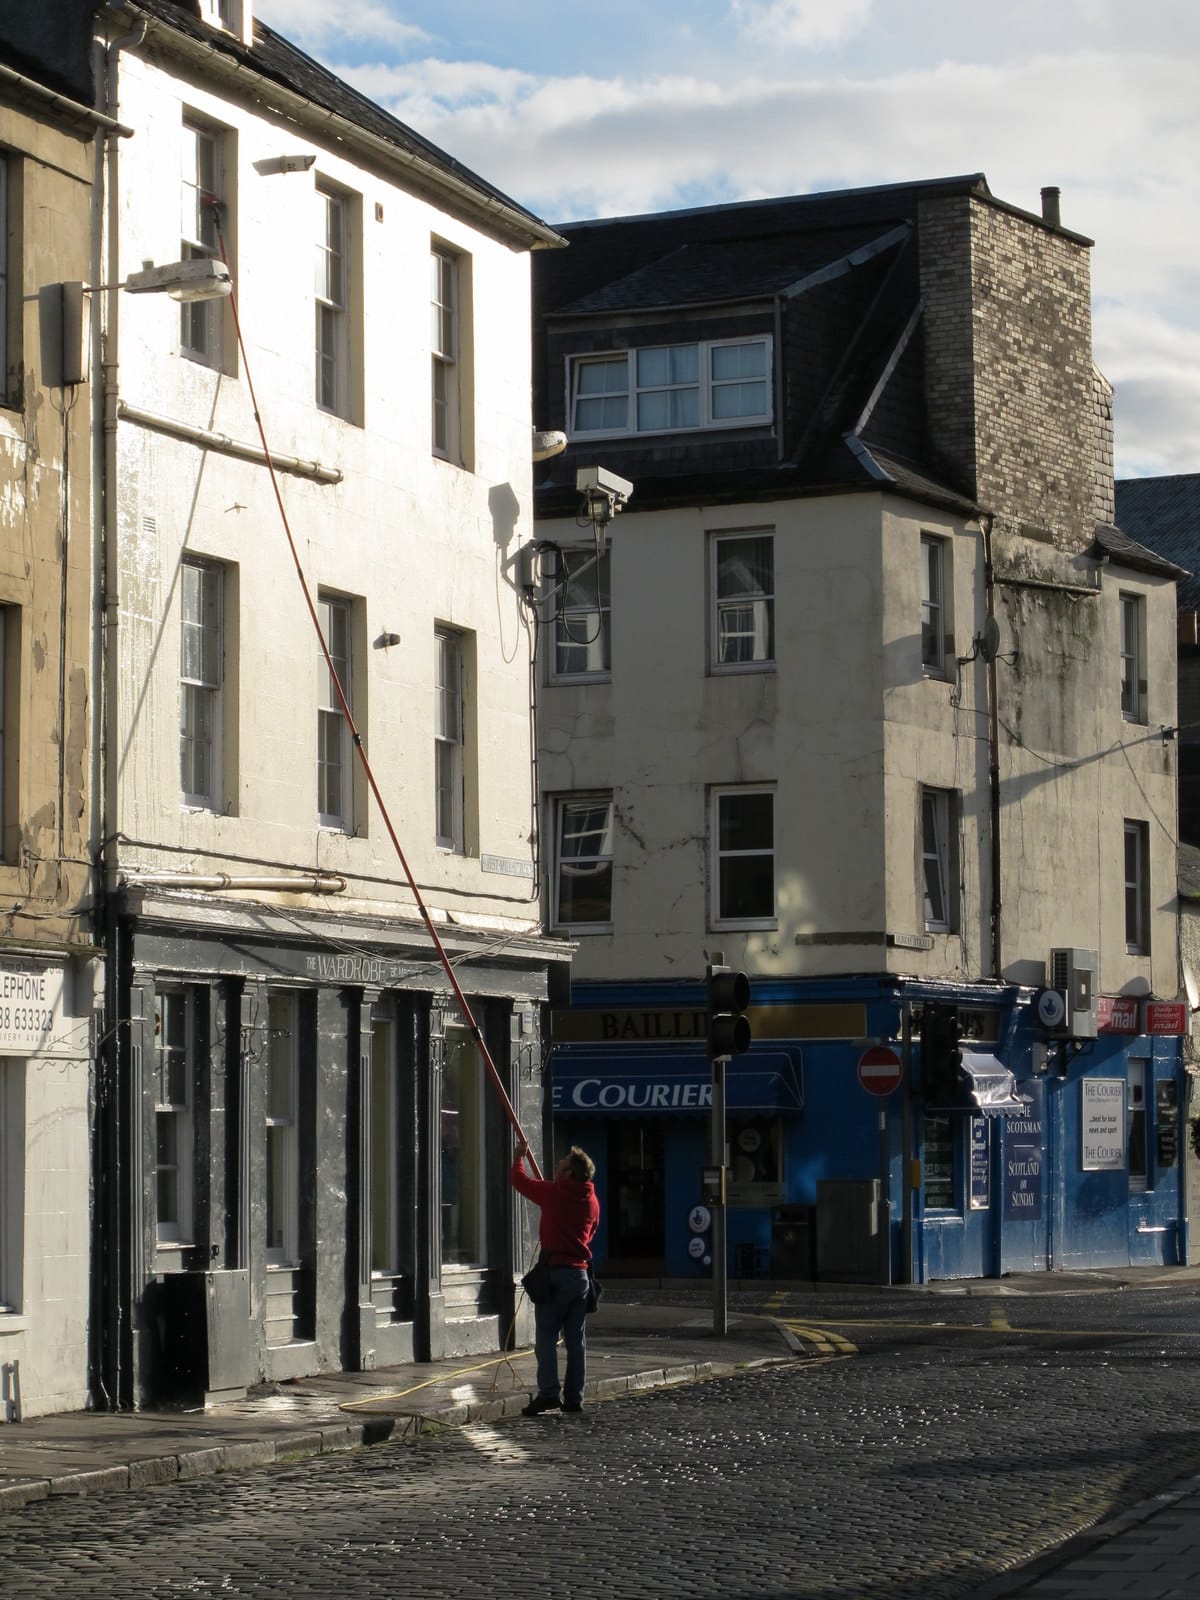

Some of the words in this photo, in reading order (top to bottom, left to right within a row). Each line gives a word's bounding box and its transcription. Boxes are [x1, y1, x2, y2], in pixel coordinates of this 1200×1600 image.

[306, 957, 316, 970] THE
[15, 1008, 53, 1031] 633323
[1111, 1003, 1137, 1030] mail
[1153, 1021, 1178, 1030] mail
[552, 1086, 563, 1107] E
[572, 1079, 713, 1108] COURIER
[1085, 1083, 1095, 1097] THE
[1096, 1083, 1122, 1097] COURIER
[1007, 1121, 1042, 1134] SCOTSMAN
[1085, 1146, 1095, 1160] THE
[1008, 1161, 1040, 1177] SCOTLAND
[1012, 1192, 1035, 1207] SUNDAY
